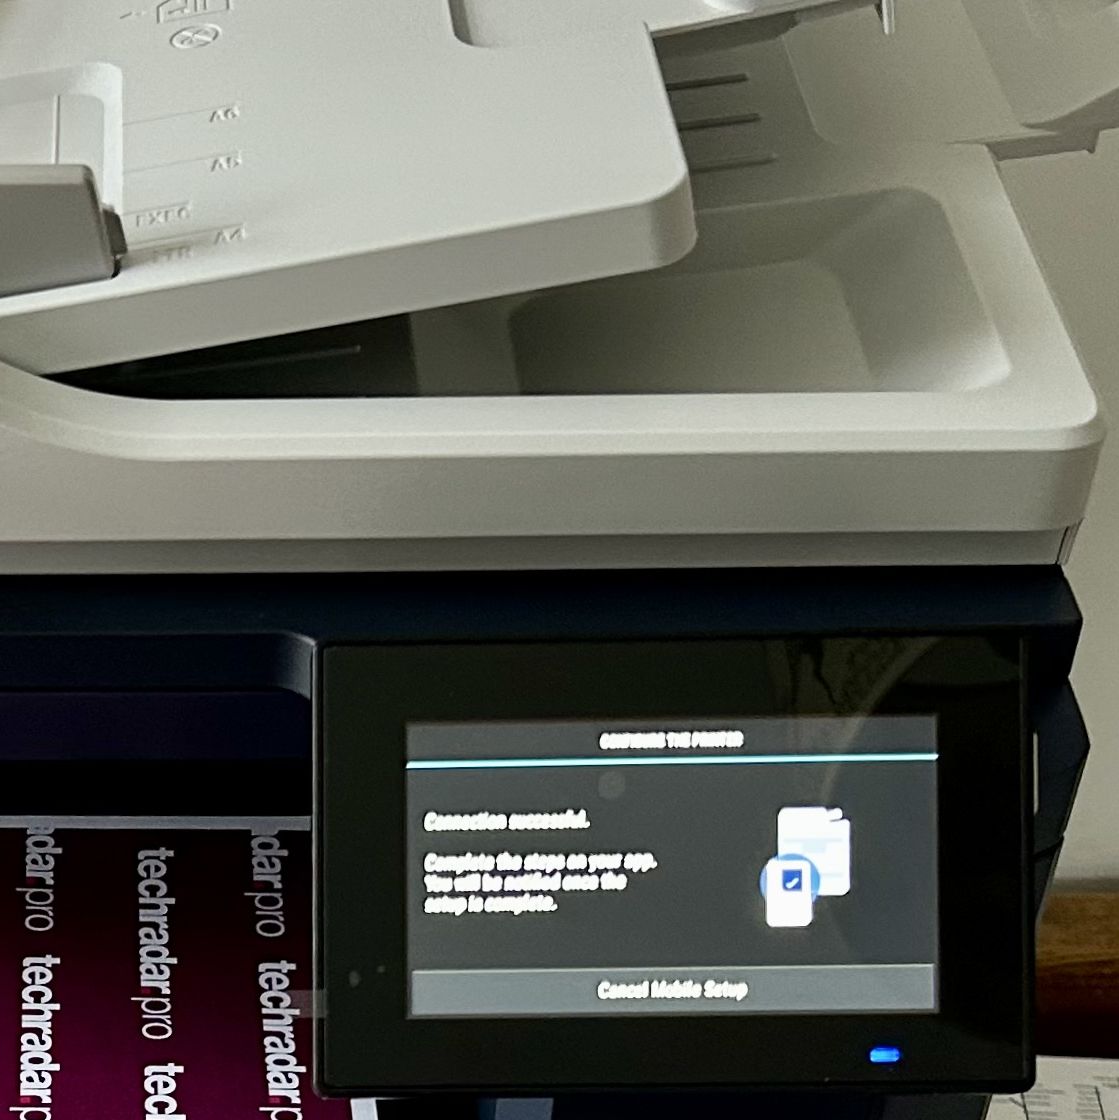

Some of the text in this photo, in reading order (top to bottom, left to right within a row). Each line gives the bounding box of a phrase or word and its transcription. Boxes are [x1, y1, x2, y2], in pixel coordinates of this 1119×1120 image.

[424, 811, 507, 831] Connection
[131, 848, 177, 1039] techradar.pro
[597, 979, 748, 1001] Cancel Mobile Setup
